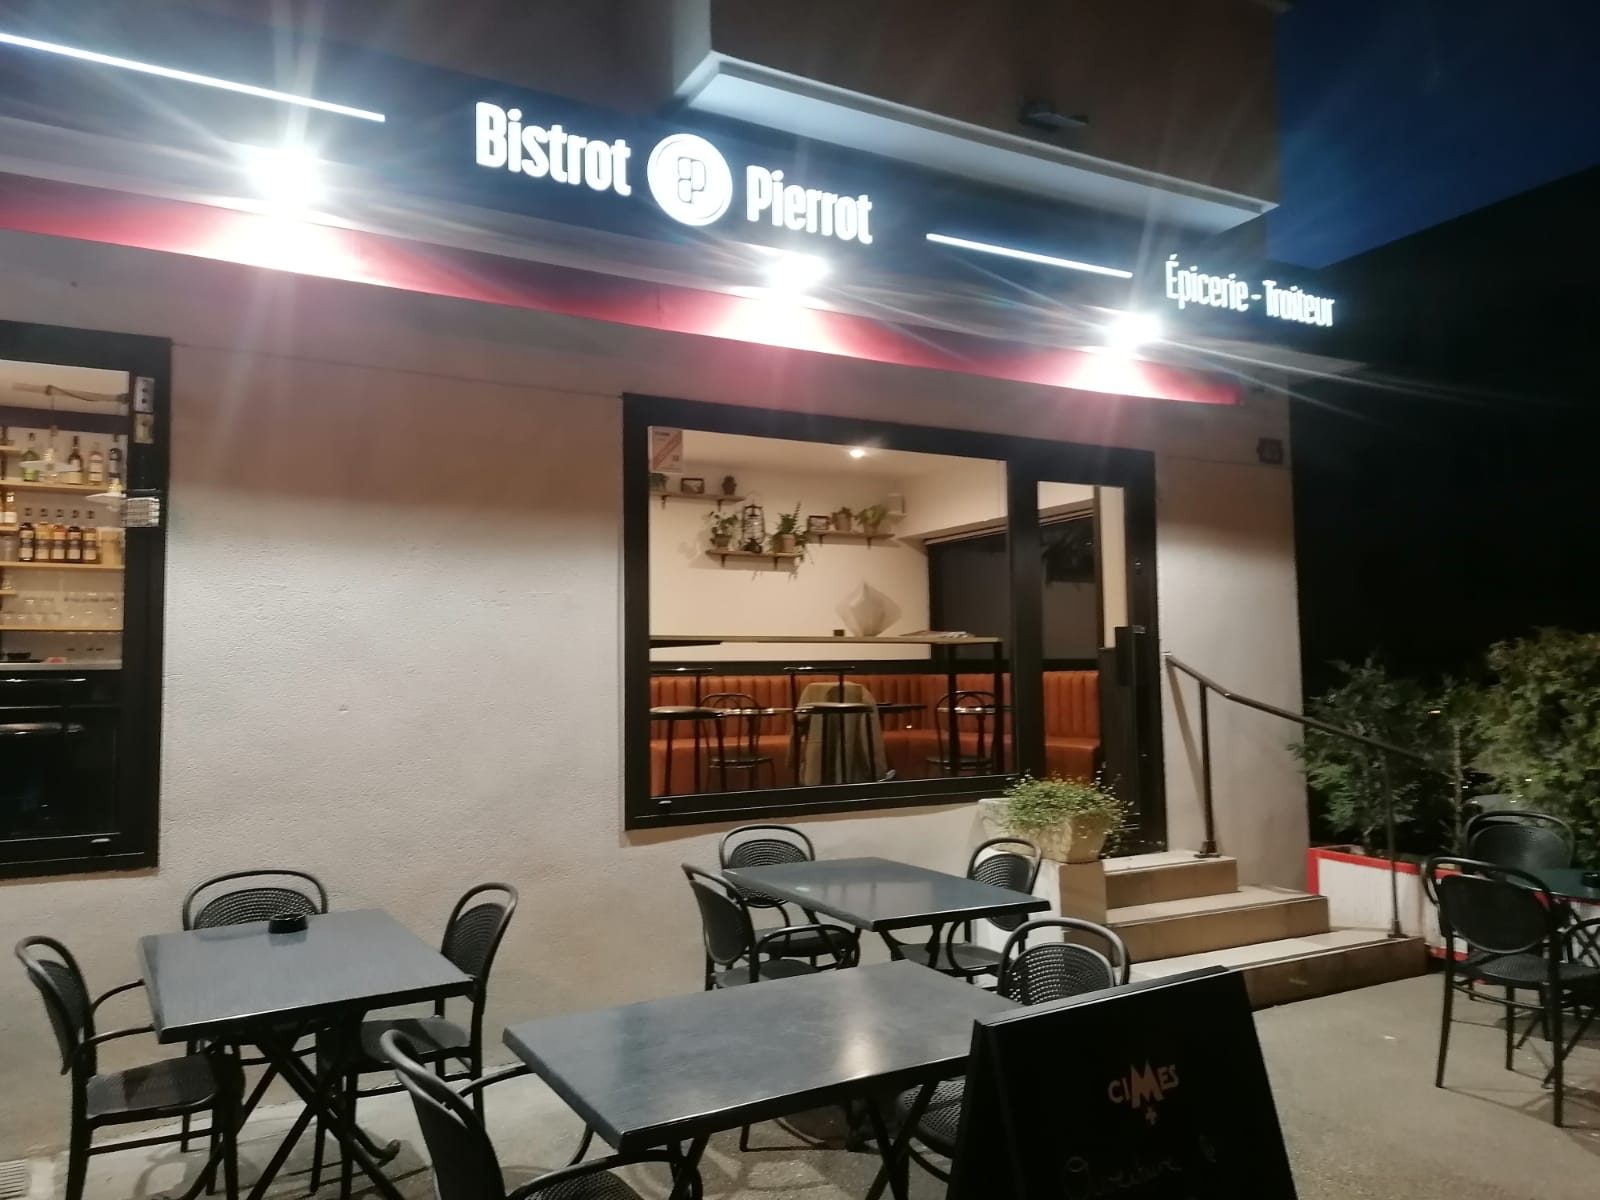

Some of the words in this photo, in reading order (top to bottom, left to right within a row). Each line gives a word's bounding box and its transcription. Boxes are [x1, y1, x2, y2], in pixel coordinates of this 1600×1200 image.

[475, 101, 632, 196] Bistrot
[745, 165, 873, 244] Pierrot
[1165, 253, 1249, 312] Épicerie
[1262, 279, 1335, 327] Traiteur
[1107, 1059, 1179, 1109] CIMES
